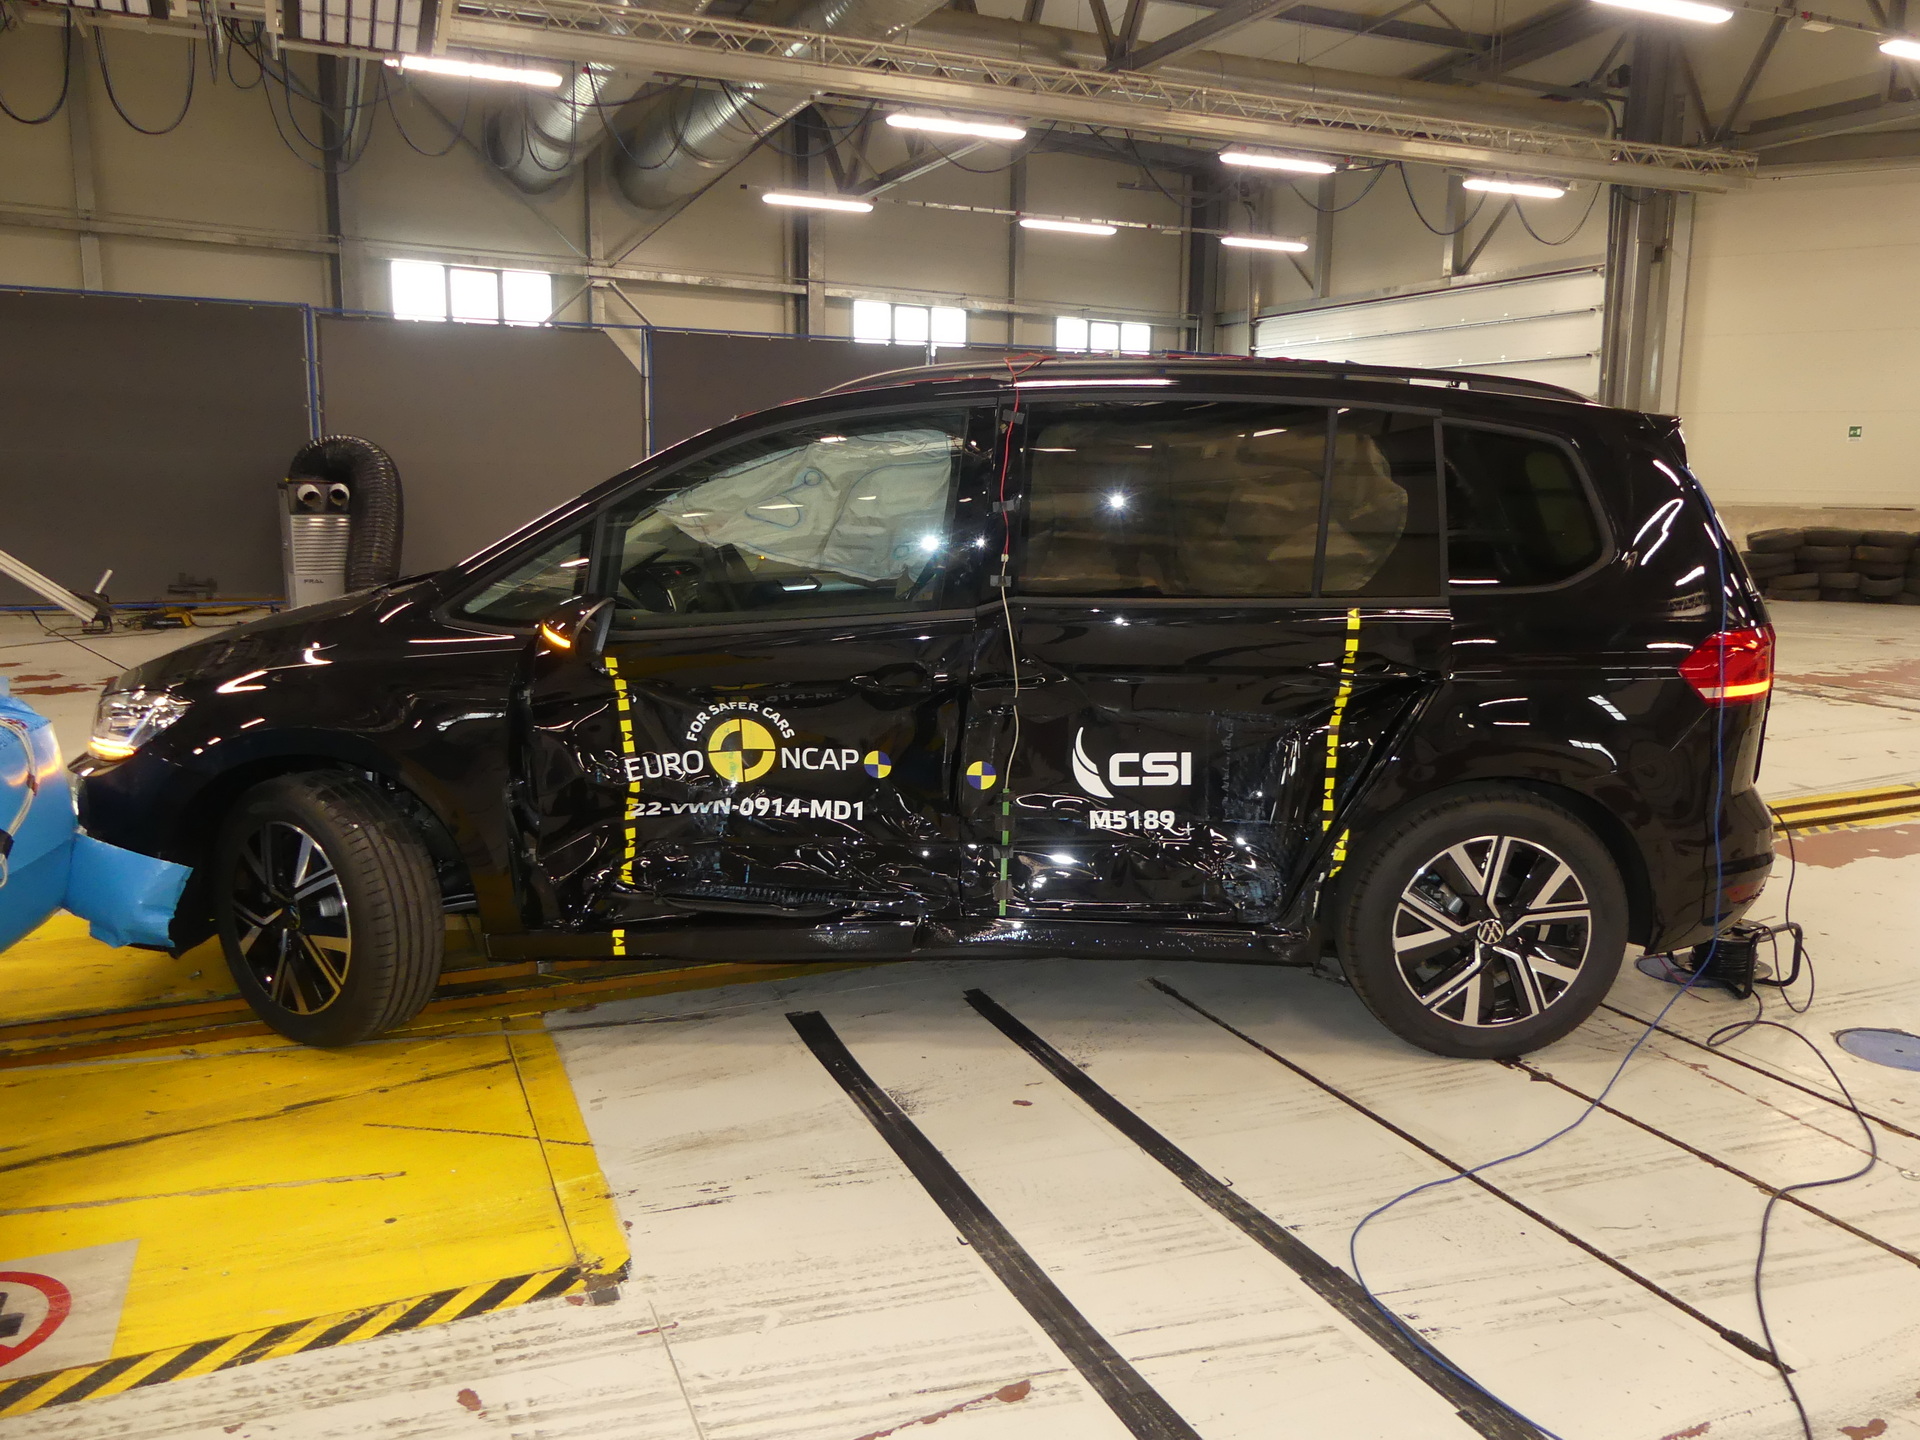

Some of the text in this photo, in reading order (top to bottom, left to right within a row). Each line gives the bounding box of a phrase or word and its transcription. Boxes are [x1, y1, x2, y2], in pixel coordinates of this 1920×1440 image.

[685, 701, 796, 742] FOR SAFER CARS
[624, 747, 859, 782] EURO NCAP
[1109, 752, 1192, 786] CSI
[1089, 810, 1176, 830] M5189
